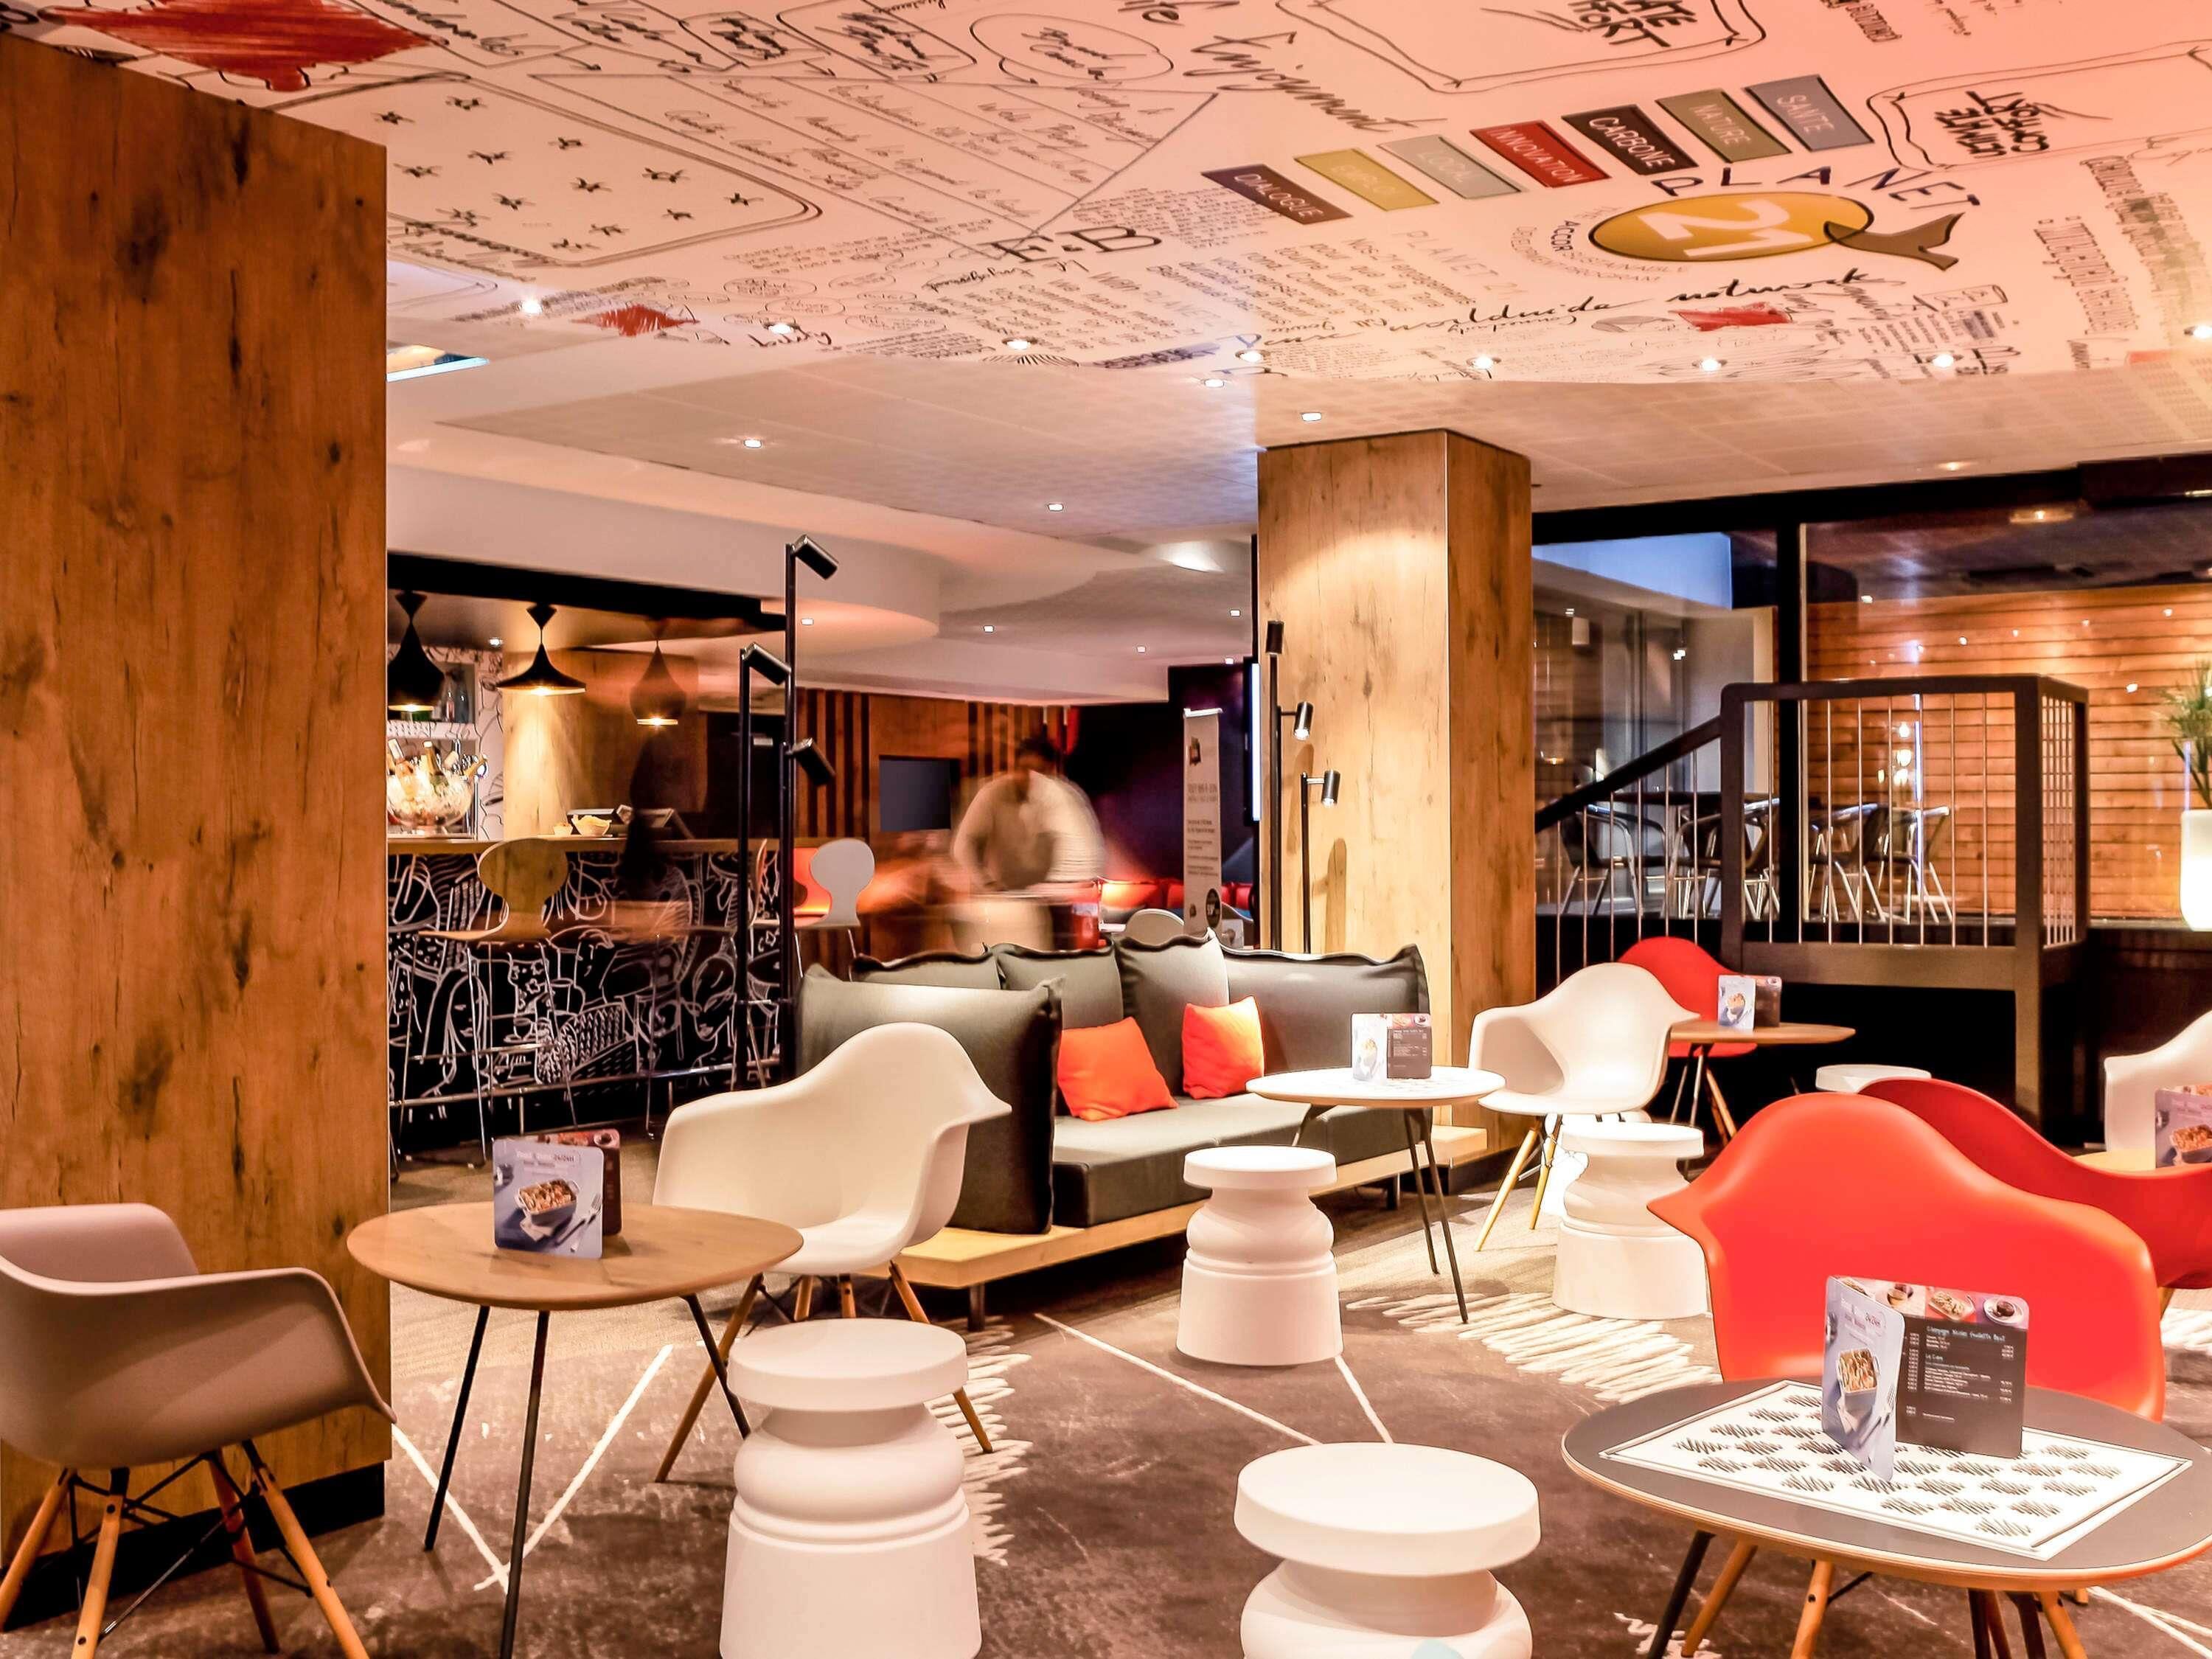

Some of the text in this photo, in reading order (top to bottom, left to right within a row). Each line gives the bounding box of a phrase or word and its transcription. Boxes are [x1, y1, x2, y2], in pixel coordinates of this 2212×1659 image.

[1183, 31, 1447, 133] Enjoyment
[1695, 105, 1750, 144] NATURE
[1775, 94, 1834, 133] SANTE
[1489, 127, 1587, 182] INNOVATION
[1590, 117, 1674, 166] CARBONE
[1418, 153, 1470, 183] LOCAL
[1233, 173, 1325, 217] DIALOGUE
[1638, 167, 1980, 258] PLANET 21
[1406, 230, 1498, 276] PLANET
[1551, 220, 1579, 251] ACCOR
